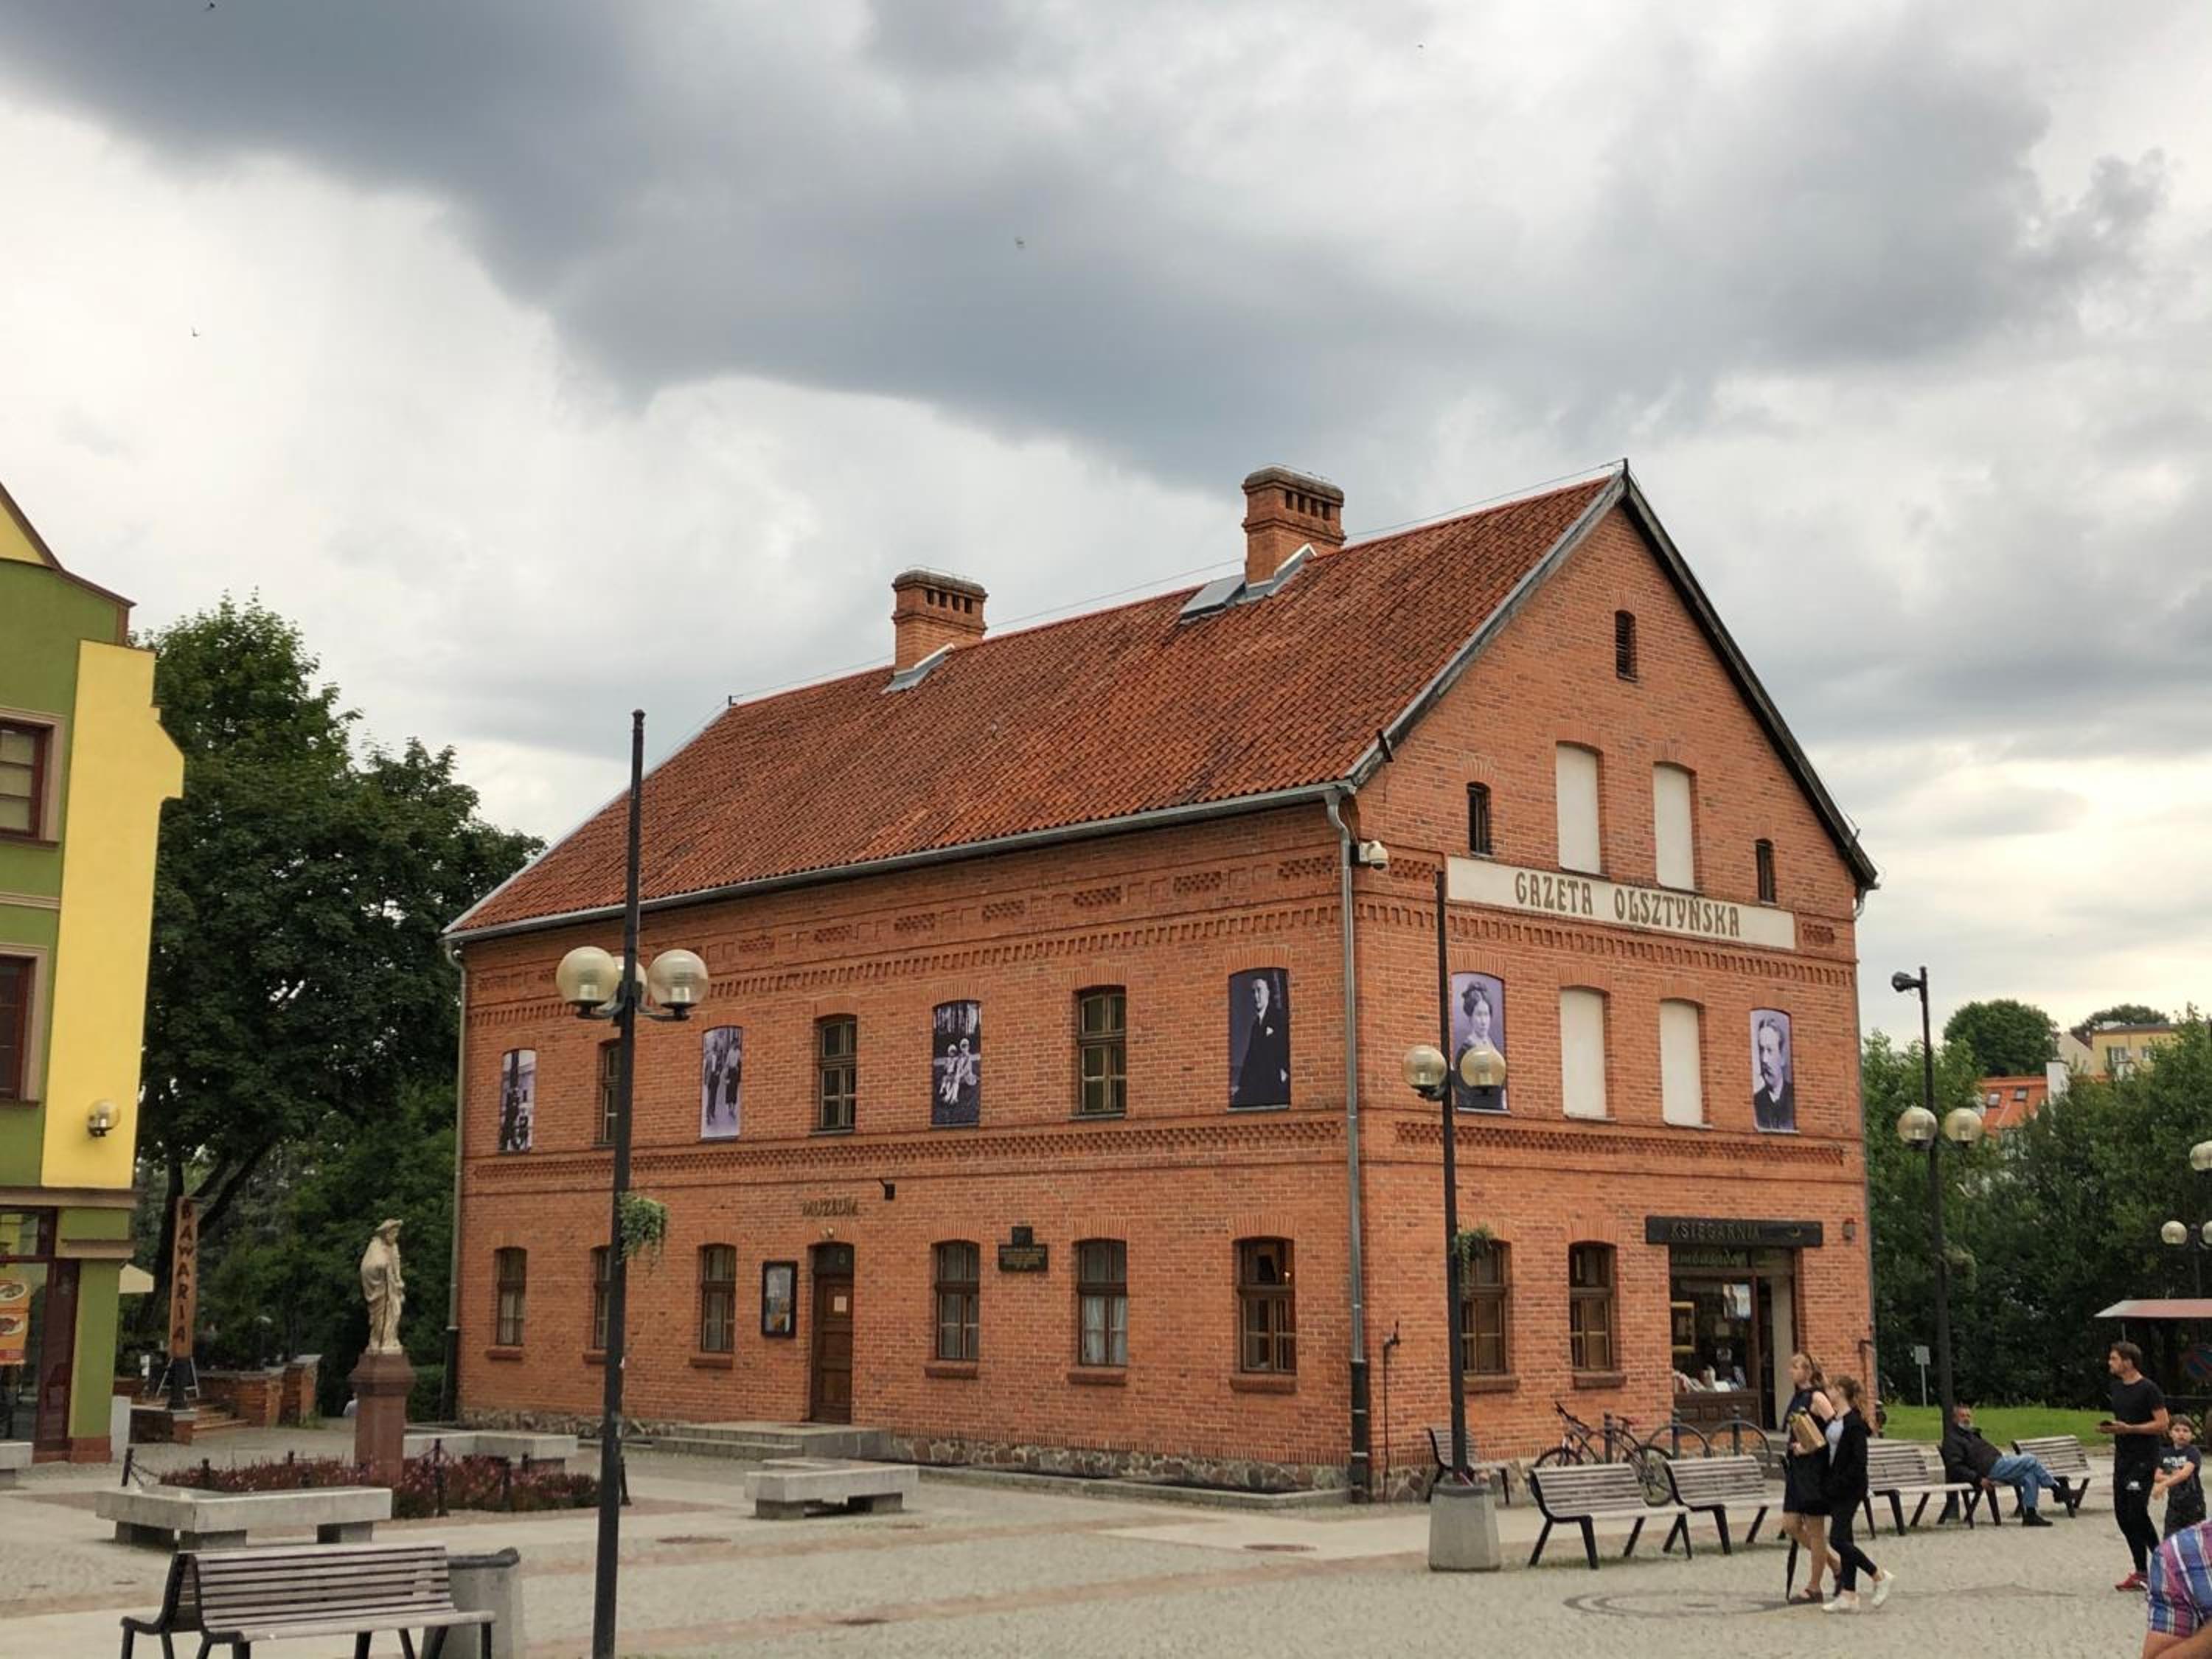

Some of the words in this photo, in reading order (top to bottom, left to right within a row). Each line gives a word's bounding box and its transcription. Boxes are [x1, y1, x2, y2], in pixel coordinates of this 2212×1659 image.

[1515, 871, 1593, 915] GAZETA
[1614, 887, 1740, 937] OLSZTYŃSKA
[802, 1197, 858, 1217] MUZEUM
[173, 1197, 195, 1343] BAWARIA
